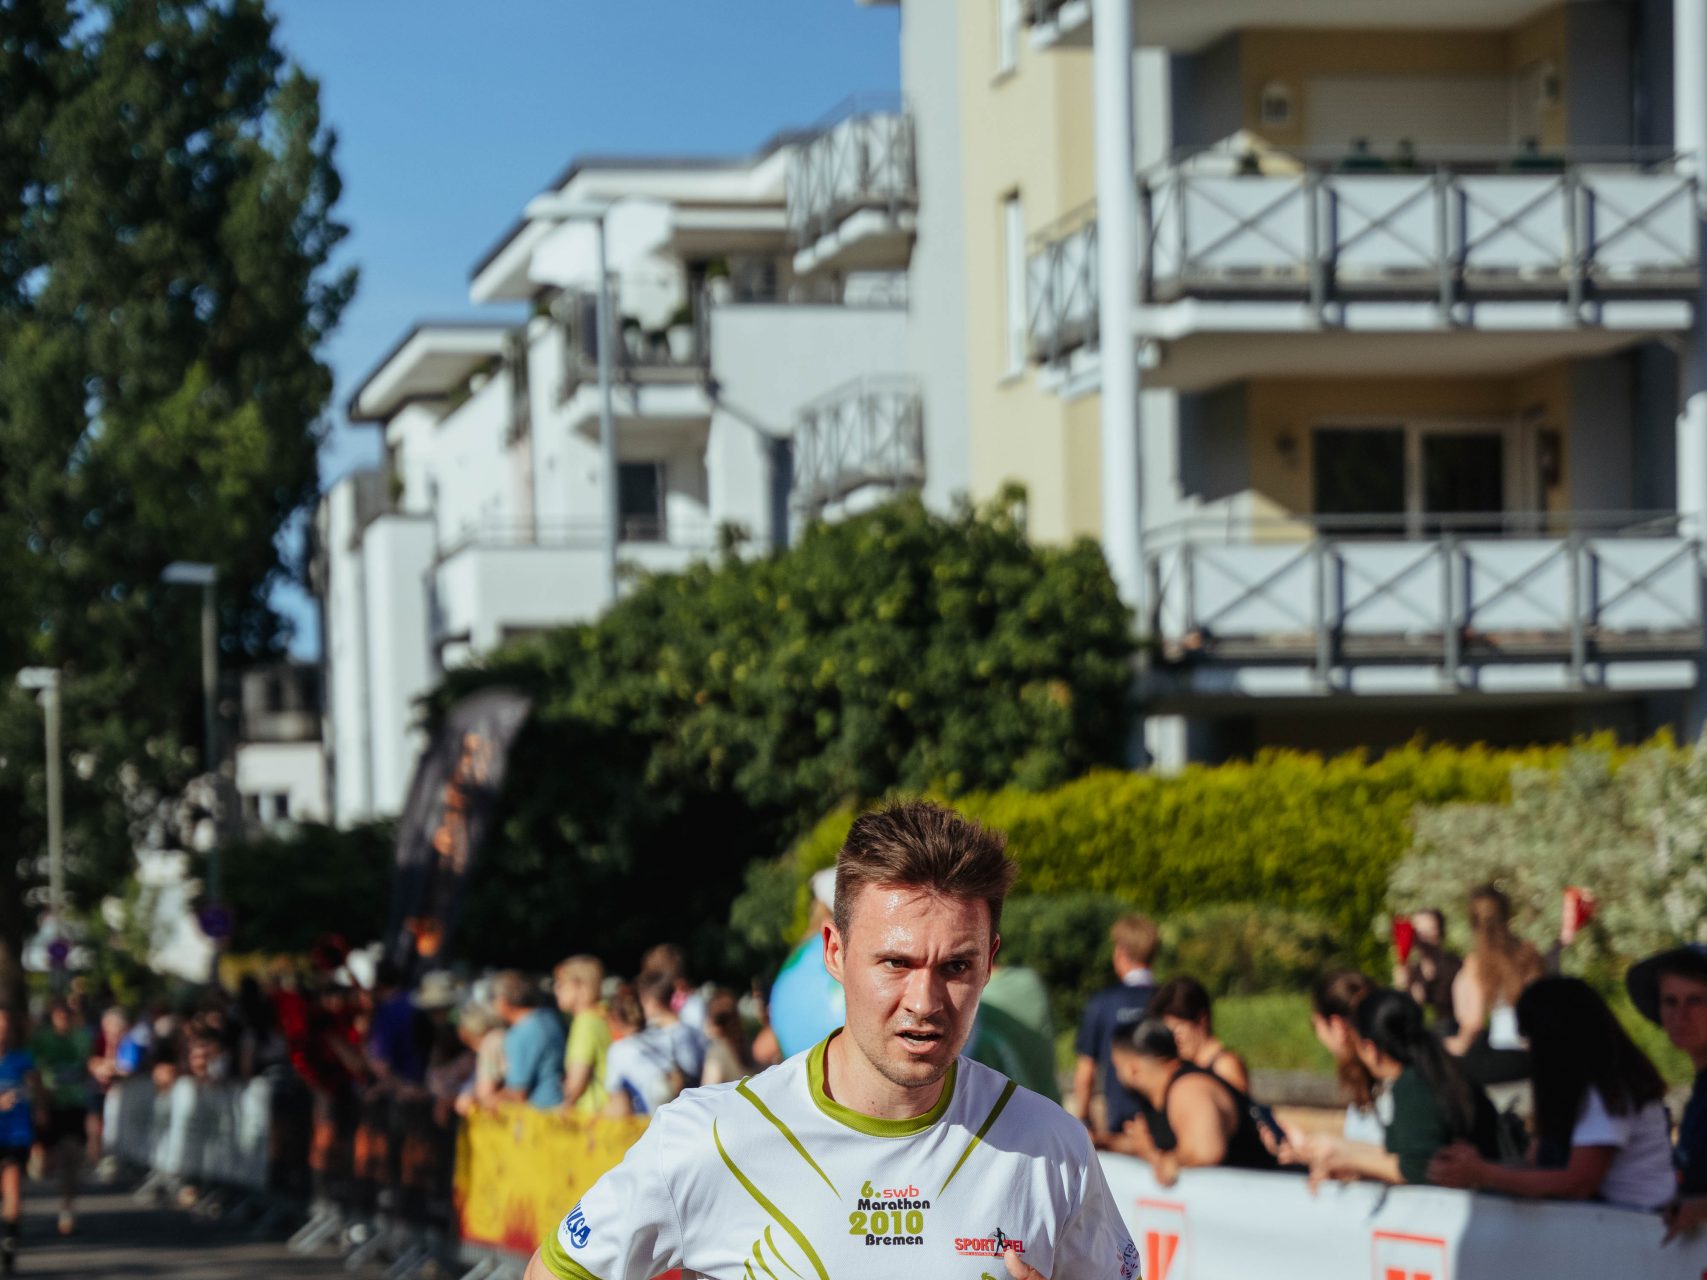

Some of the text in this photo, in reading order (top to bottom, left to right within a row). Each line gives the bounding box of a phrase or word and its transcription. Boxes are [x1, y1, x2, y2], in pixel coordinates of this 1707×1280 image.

[861, 1181, 919, 1198] 6. swb
[858, 1198, 931, 1210] Marathon
[849, 1210, 923, 1235] 2010
[865, 1233, 924, 1246] Bremen
[954, 1238, 996, 1251] SPORT
